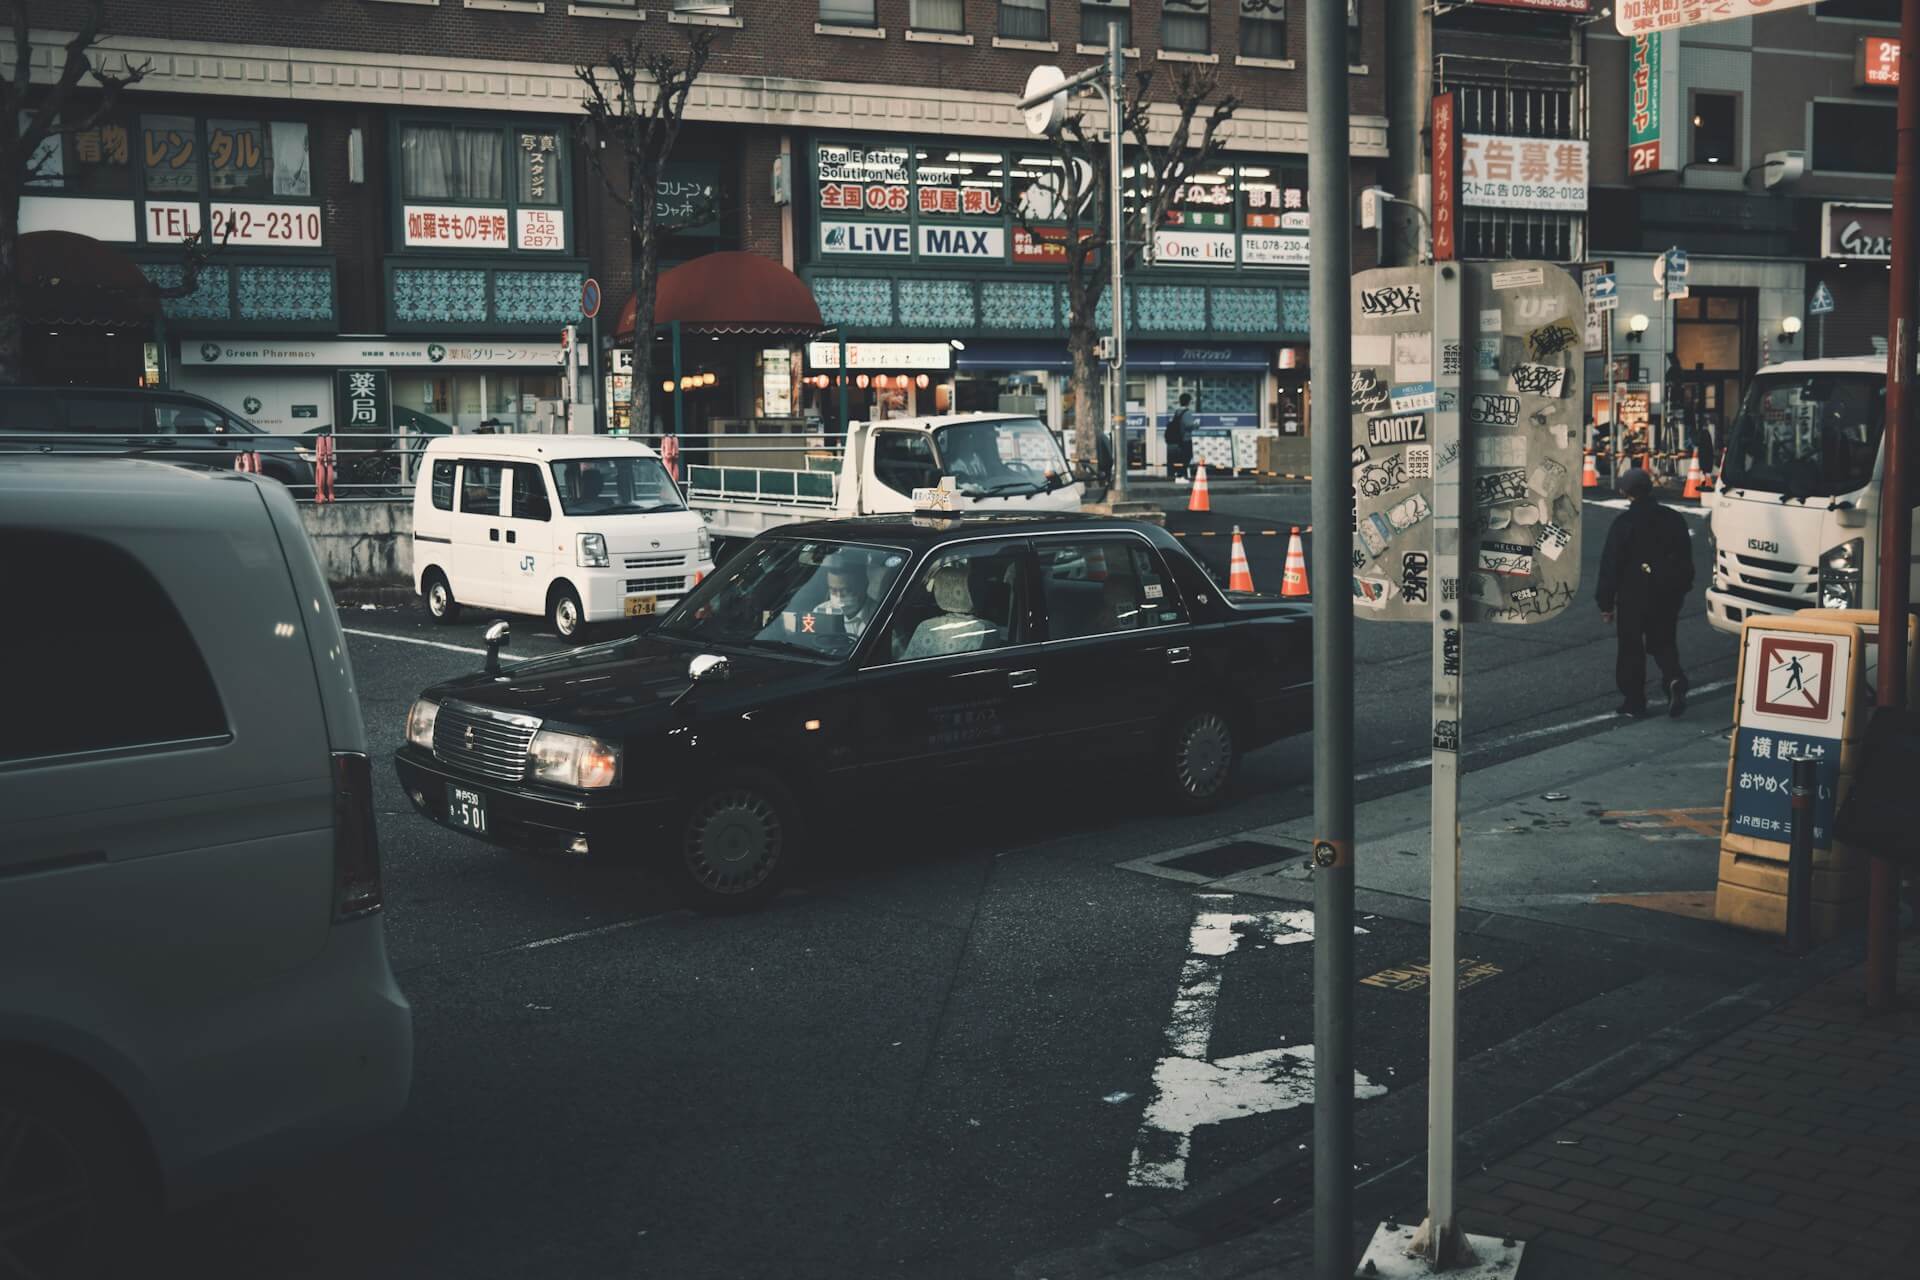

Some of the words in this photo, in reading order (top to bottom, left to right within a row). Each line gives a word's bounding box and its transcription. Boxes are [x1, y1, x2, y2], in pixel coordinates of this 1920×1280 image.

[1879, 43, 1900, 63] 2F
[521, 134, 555, 152] 写真
[820, 150, 849, 163] Real
[1463, 138, 1584, 185] 広告募集
[1633, 149, 1657, 171] 2F
[531, 153, 545, 197] スタジオ
[1512, 188, 1584, 199] 078-362-0123
[151, 208, 198, 237] TEL
[528, 212, 553, 223] TEL
[408, 212, 507, 241] 伽羅きもの学院
[526, 224, 555, 235] 242
[523, 236, 559, 247] 2871
[848, 226, 910, 252] LiVE
[927, 230, 988, 254] MAX
[1166, 241, 1199, 257] One
[1206, 242, 1232, 258] Life
[225, 348, 258, 359] Green
[261, 349, 317, 362] Pharmacy
[349, 373, 376, 425] 薬局
[1747, 538, 1780, 553] ISUZU
[520, 555, 536, 572] JR
[1739, 772, 1832, 800] おやめくい
[1736, 815, 1780, 832] JR西日本
